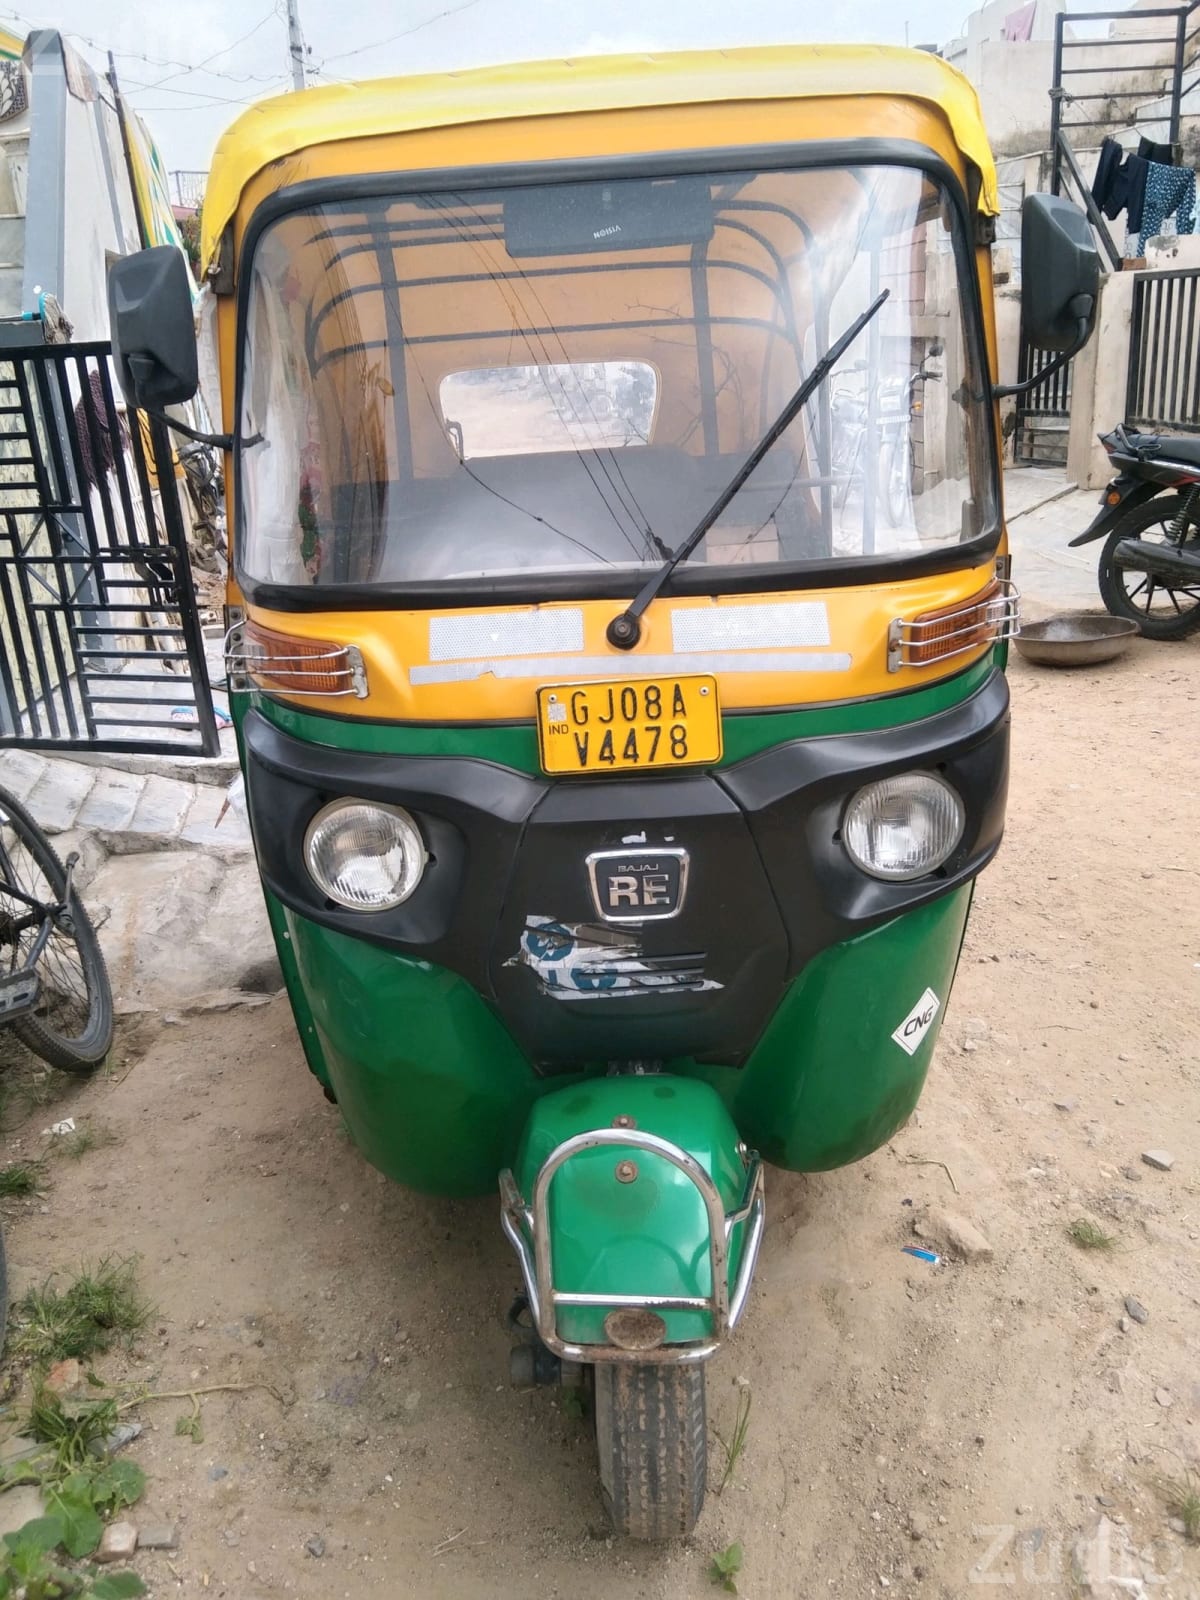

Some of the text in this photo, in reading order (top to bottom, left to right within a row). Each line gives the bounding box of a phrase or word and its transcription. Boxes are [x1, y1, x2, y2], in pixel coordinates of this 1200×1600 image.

[593, 224, 622, 240] VISION
[548, 724, 569, 735] IND
[574, 724, 688, 767] V4478
[617, 863, 659, 872] BAJAJ
[608, 874, 671, 907] RE
[903, 1005, 934, 1037] CNG
